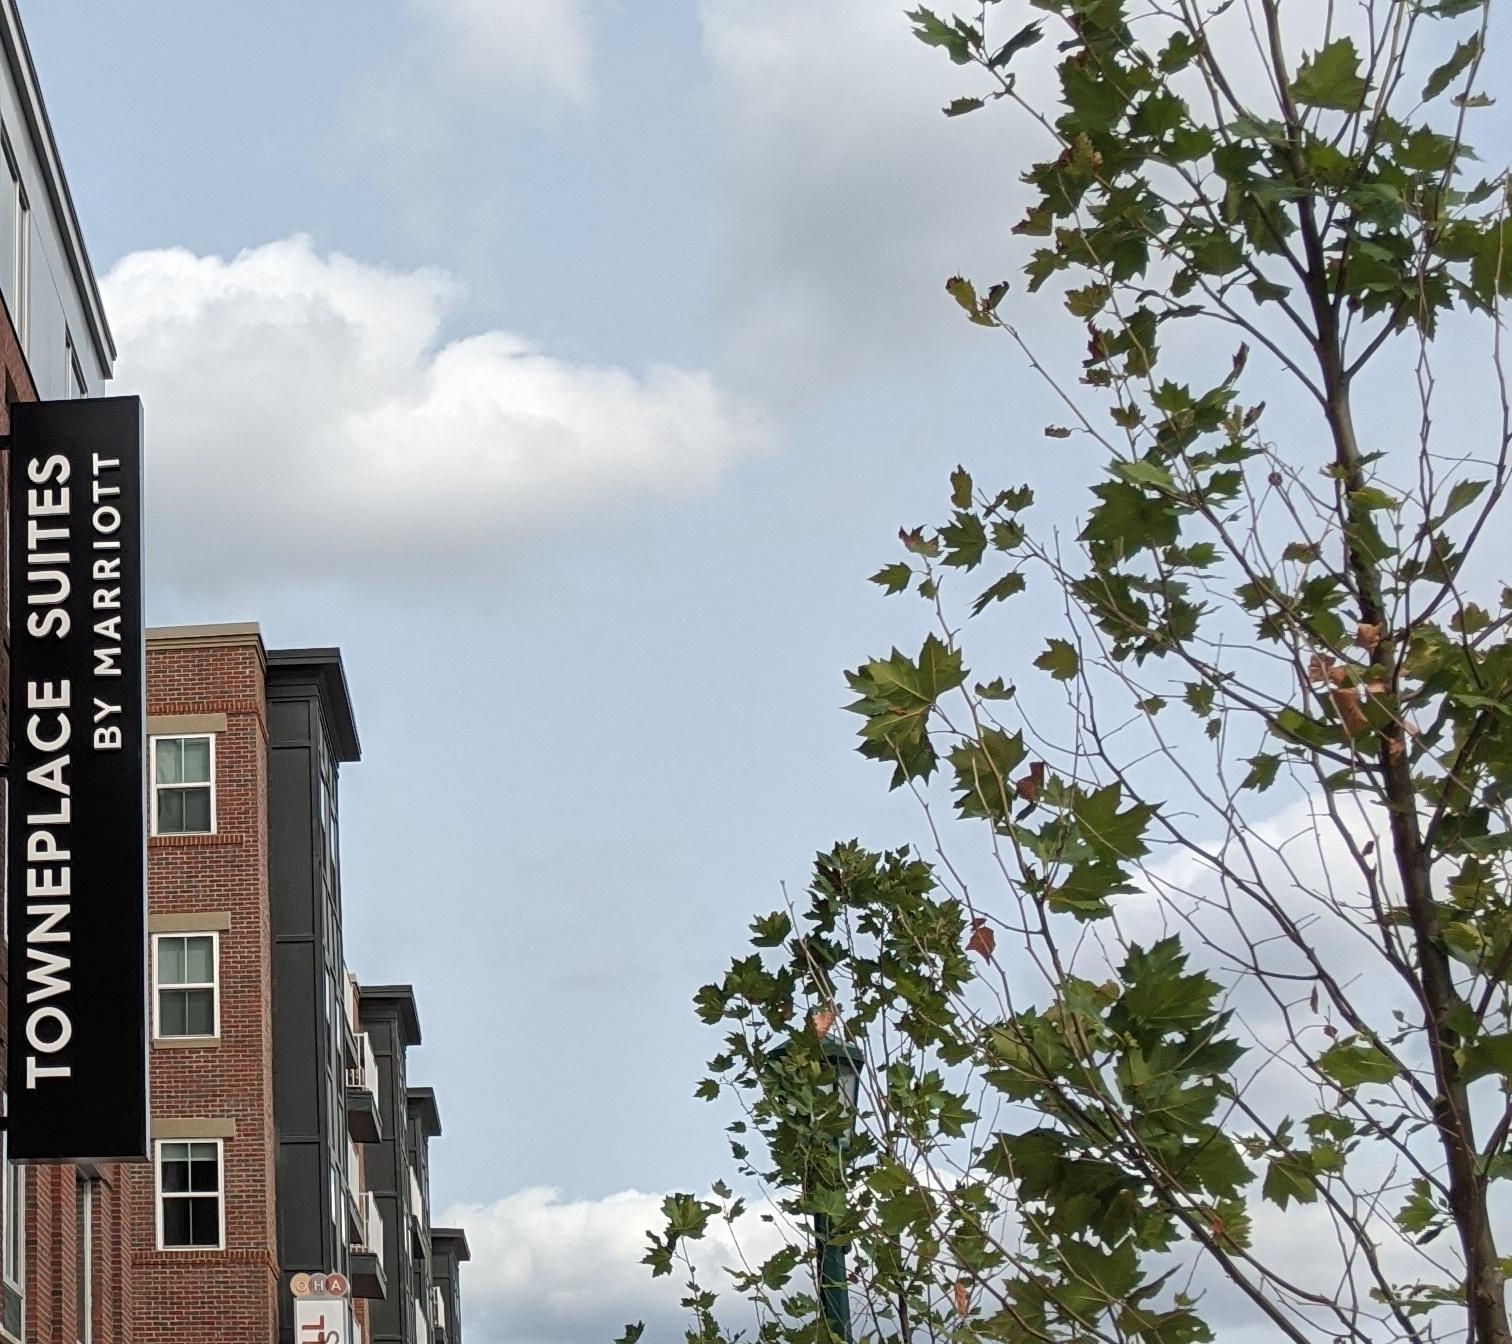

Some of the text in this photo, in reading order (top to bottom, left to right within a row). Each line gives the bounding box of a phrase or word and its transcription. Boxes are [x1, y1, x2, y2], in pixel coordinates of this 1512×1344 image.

[26, 454, 72, 1089] TOWNEPLACE SUITES
[92, 453, 122, 750] BY MARRIOTT
